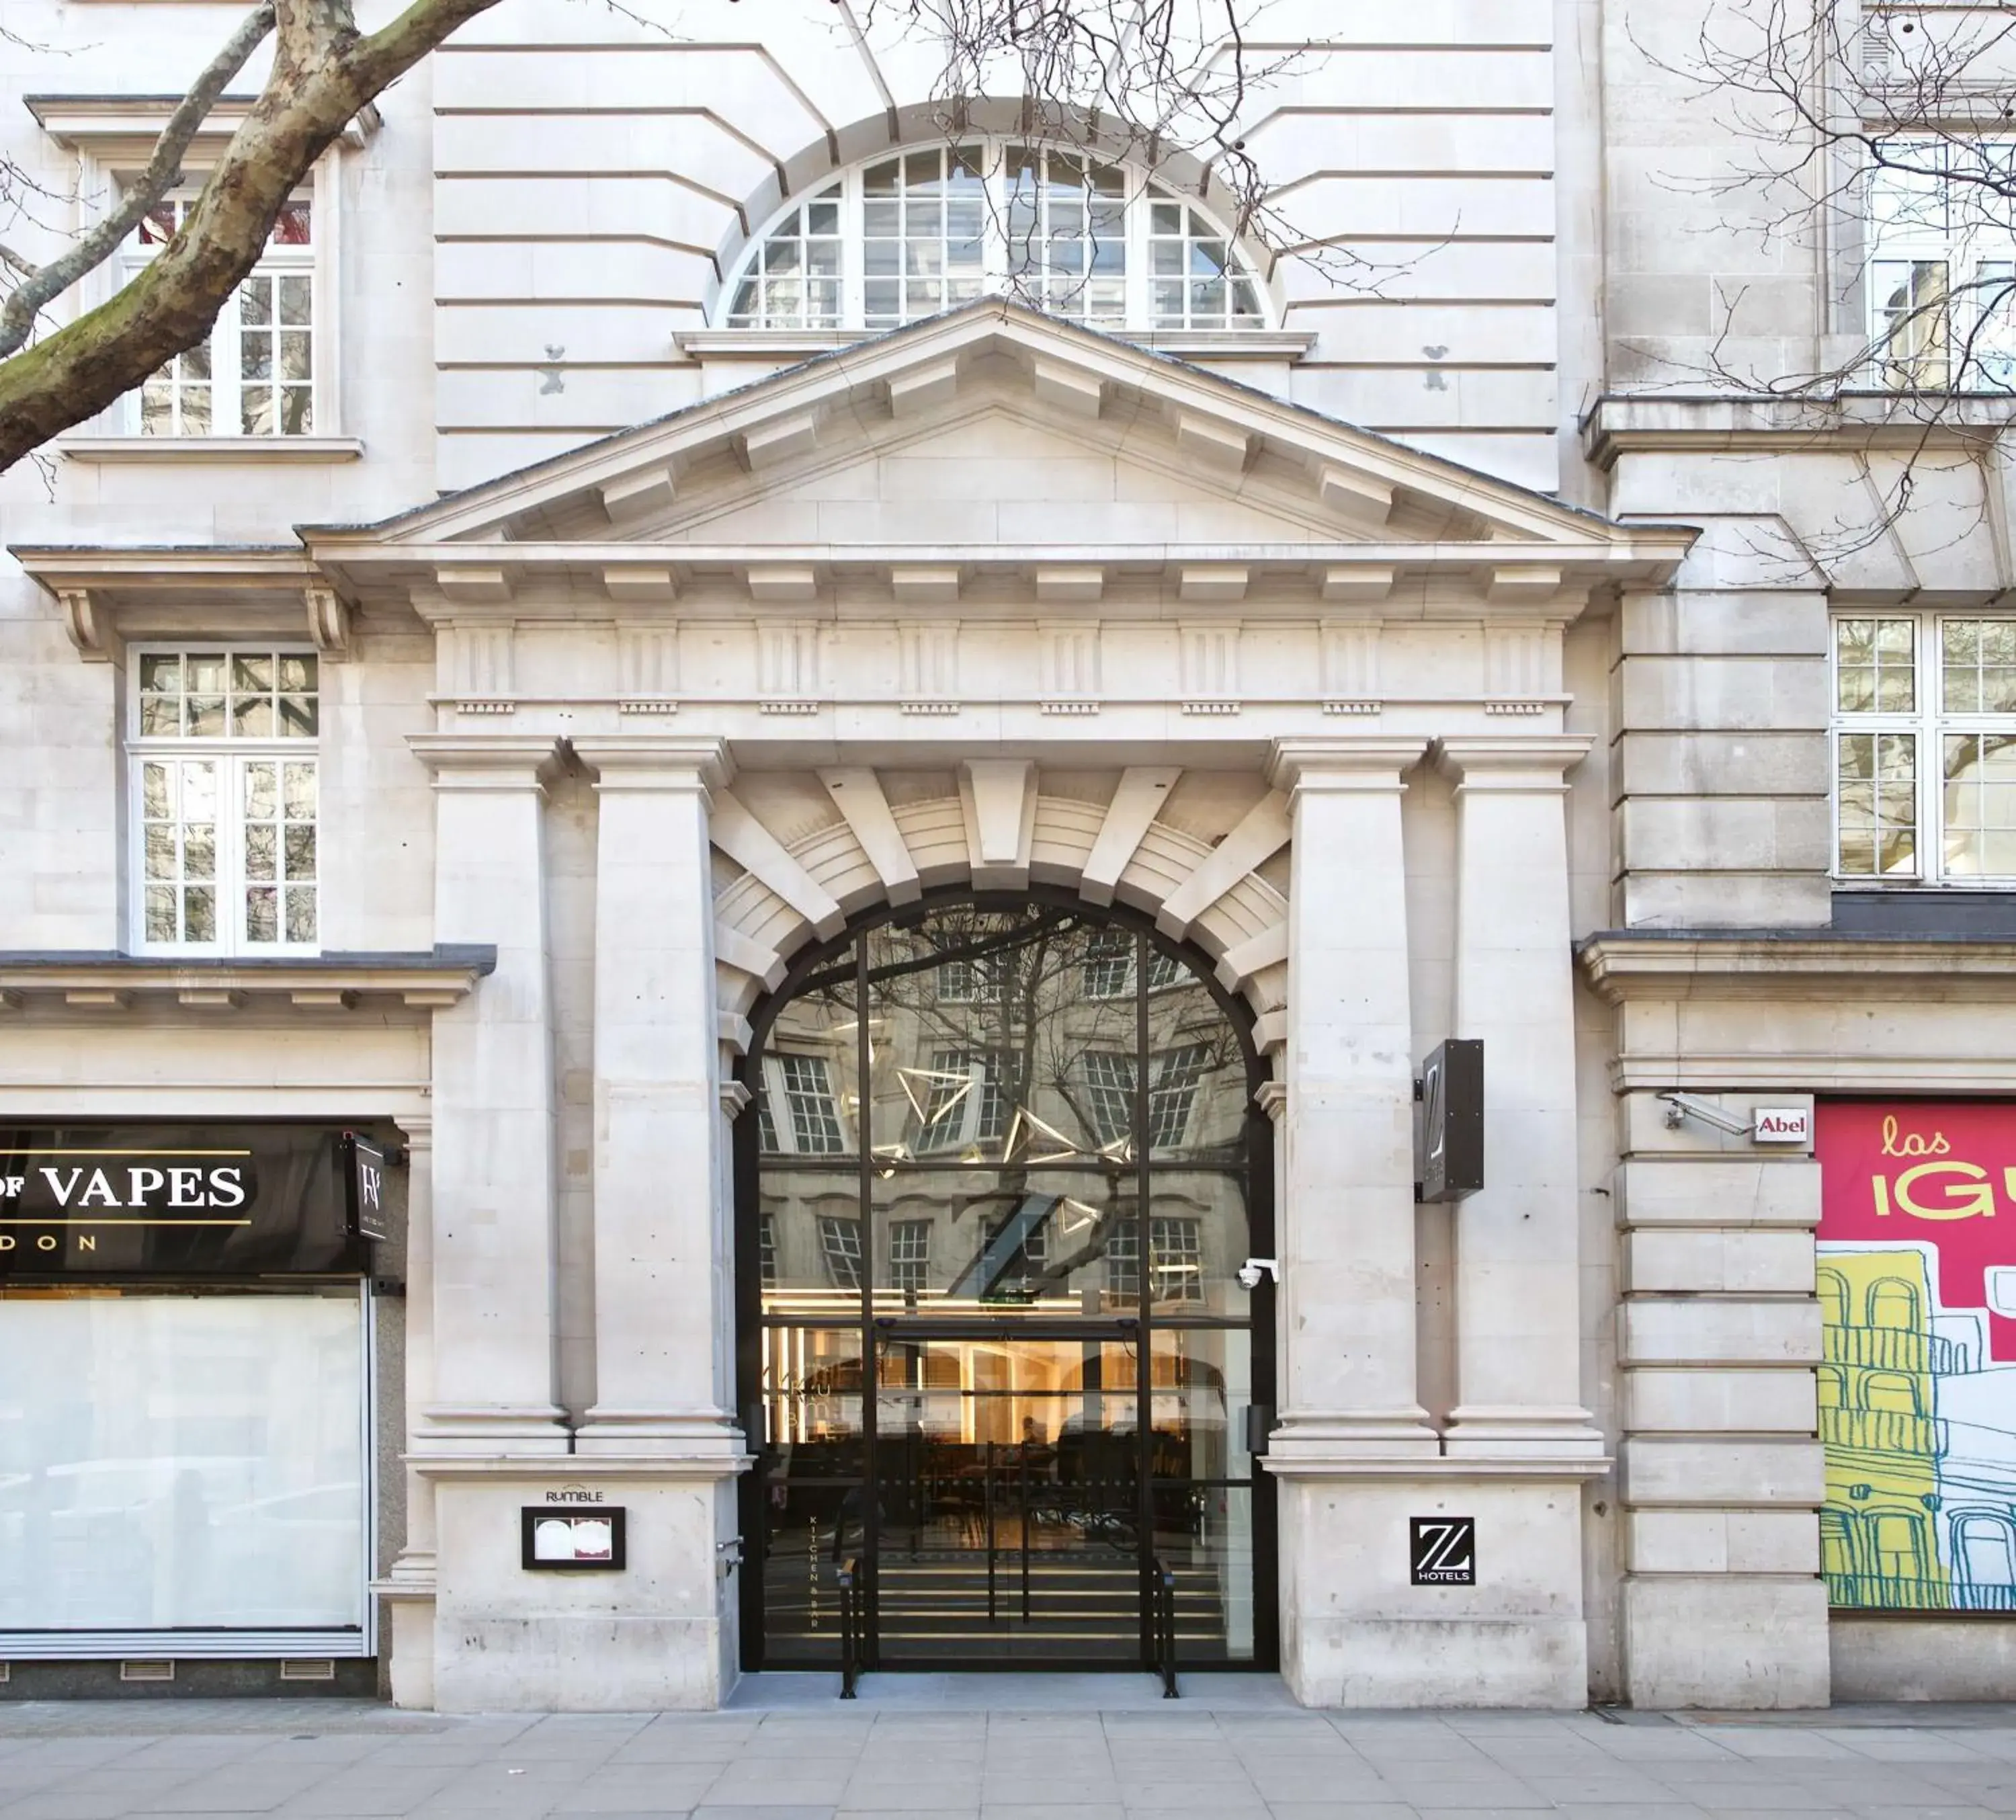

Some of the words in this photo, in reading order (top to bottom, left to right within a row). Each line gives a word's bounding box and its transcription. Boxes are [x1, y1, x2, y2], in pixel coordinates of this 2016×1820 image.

[1759, 1117, 1805, 1132] Abel
[1882, 1115, 1951, 1157] las
[38, 1167, 246, 1207] VAPES
[1872, 1160, 2016, 1220] IG
[0, 1235, 96, 1251] DON
[546, 1491, 603, 1503] RUMBLE
[808, 1516, 818, 1581] KITCHEN
[1416, 1524, 1470, 1570] Z
[1419, 1571, 1470, 1581] HOTELS
